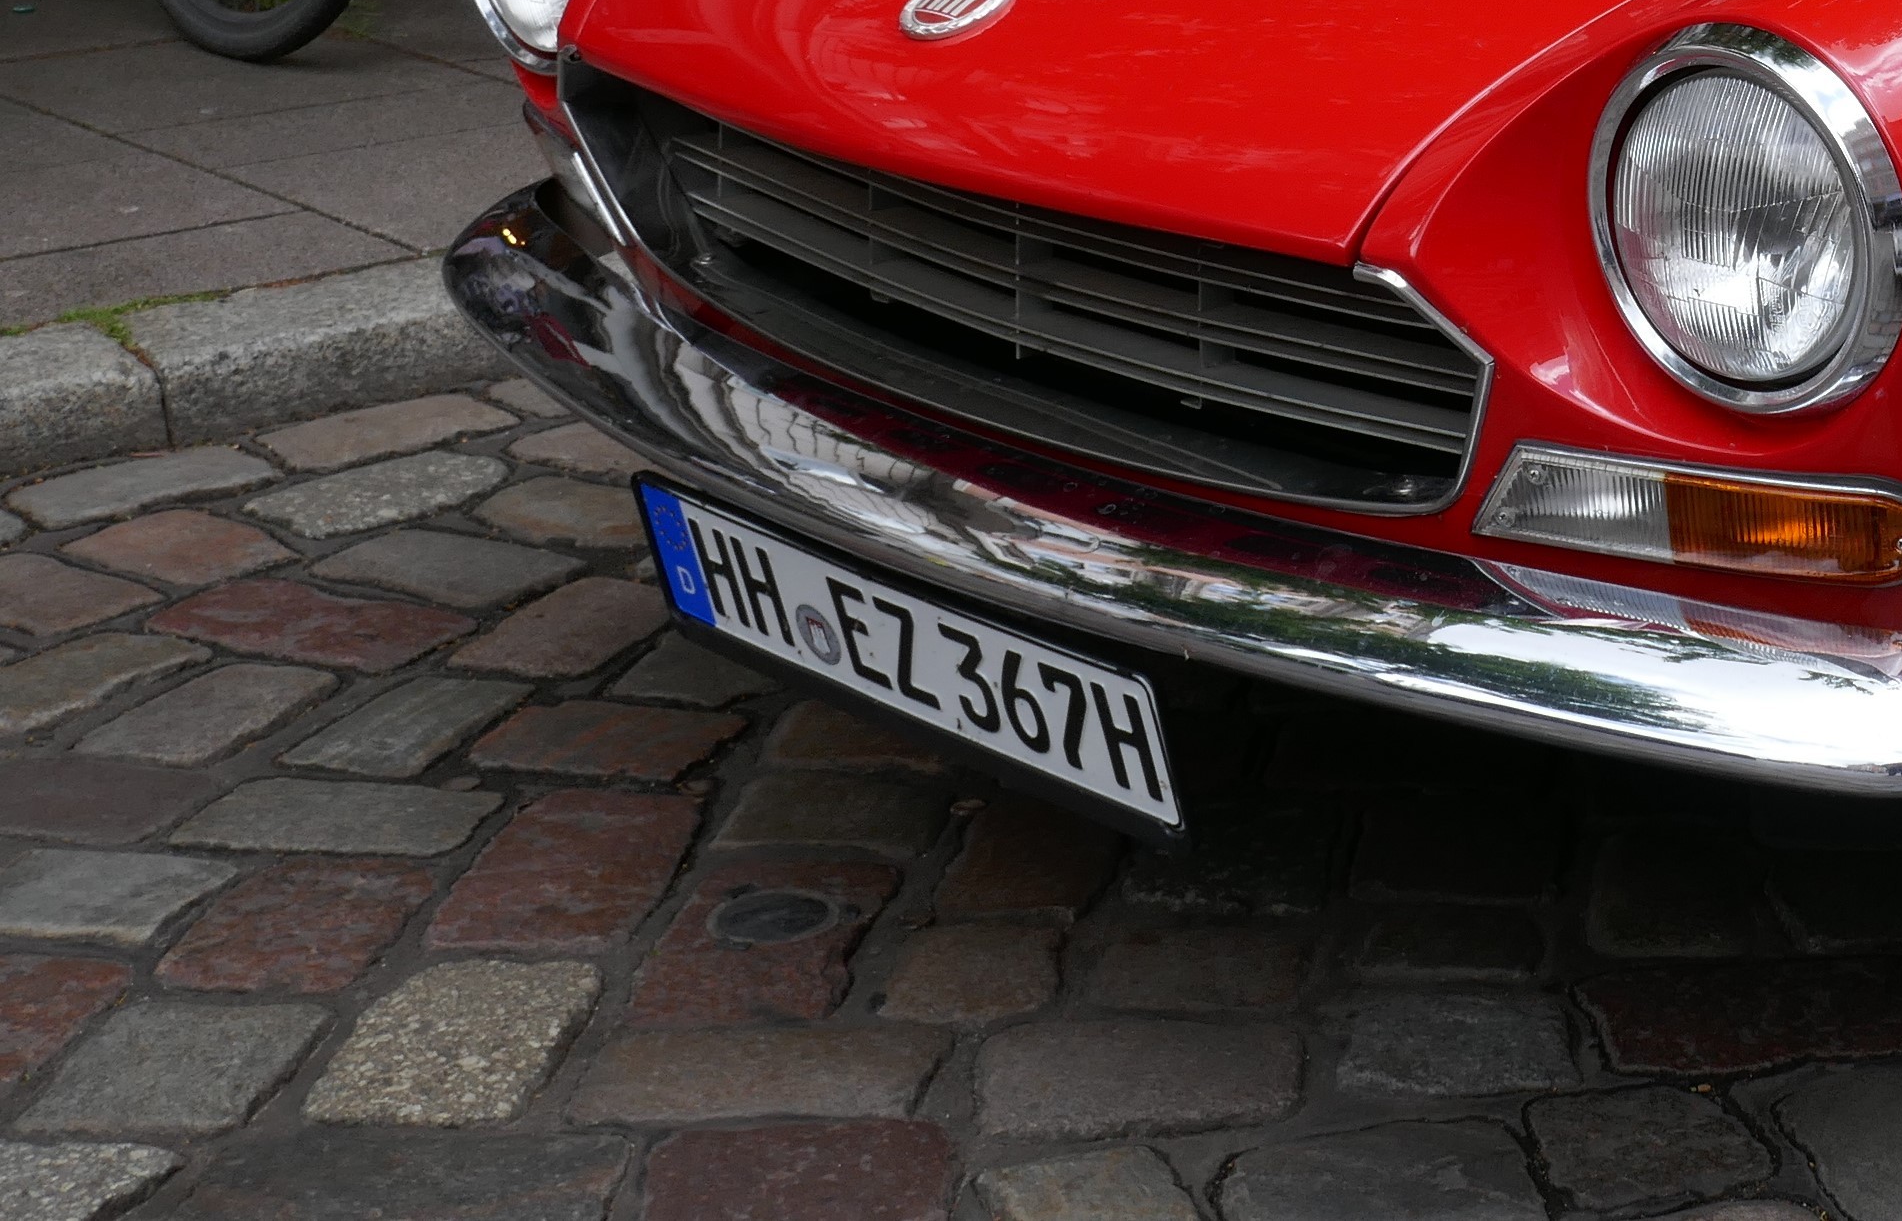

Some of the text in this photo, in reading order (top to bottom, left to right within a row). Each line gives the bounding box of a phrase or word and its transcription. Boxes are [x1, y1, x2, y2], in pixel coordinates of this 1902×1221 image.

[677, 565, 695, 595] D
[688, 518, 1164, 803] HH EZ 367H
